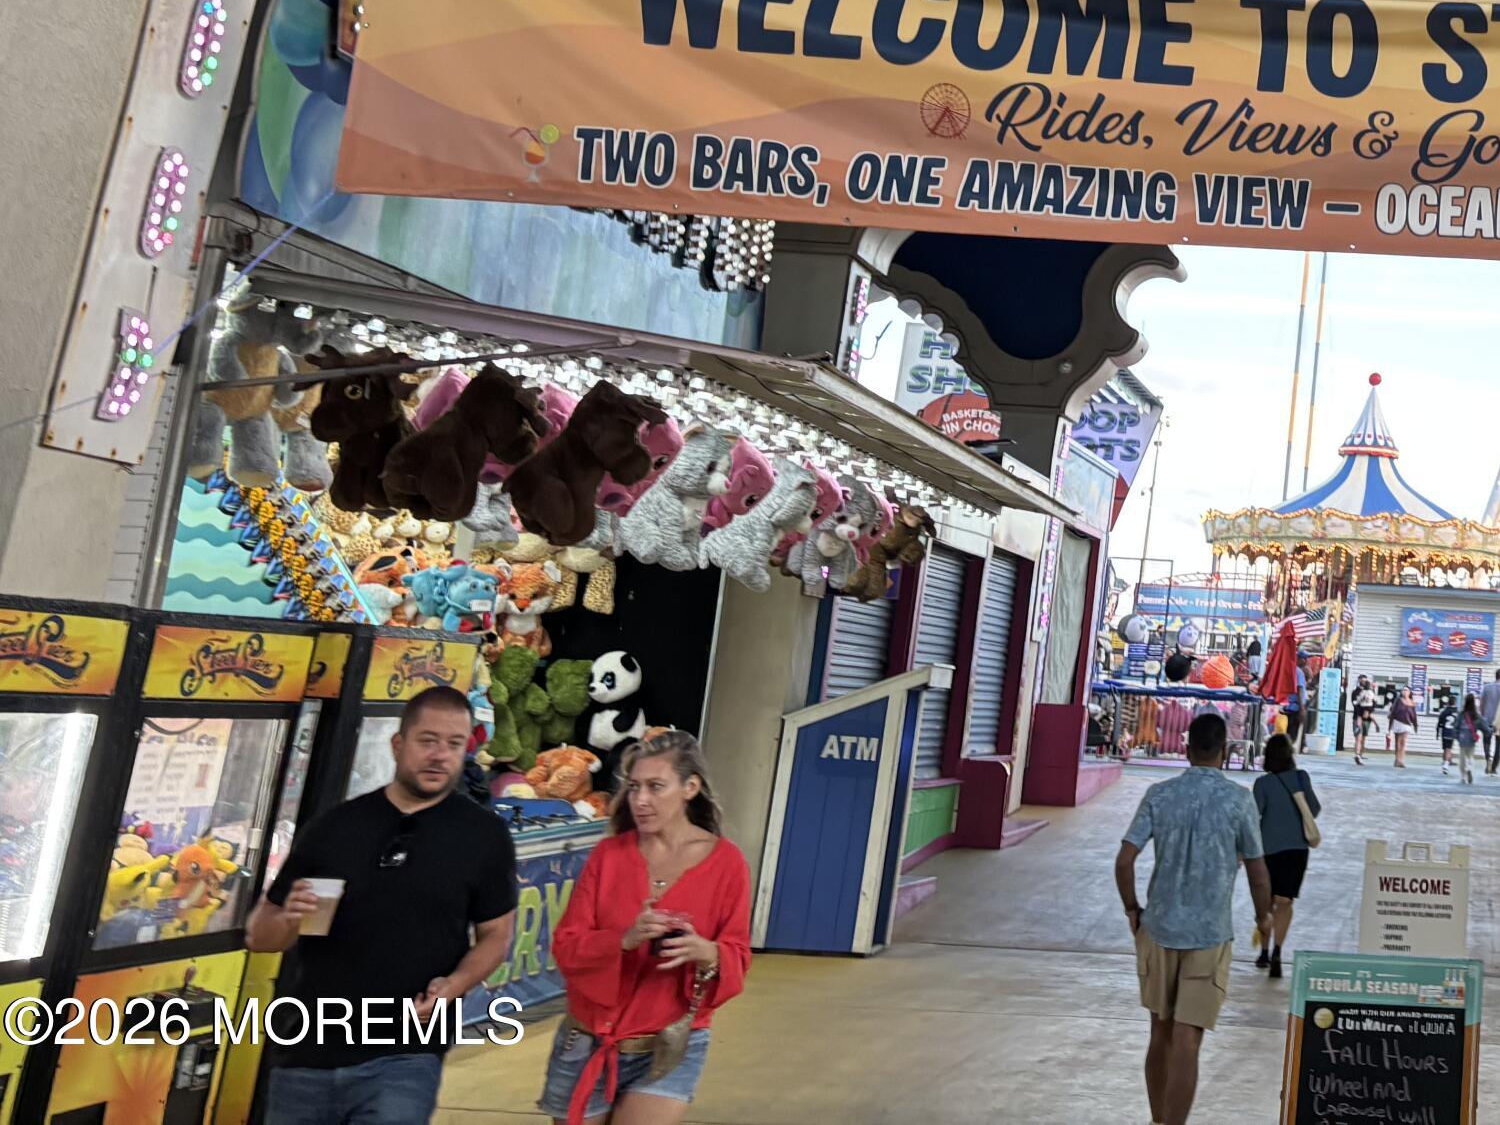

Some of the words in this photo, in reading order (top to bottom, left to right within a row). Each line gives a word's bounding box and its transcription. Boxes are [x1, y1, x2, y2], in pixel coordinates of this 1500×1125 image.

[985, 82, 1153, 153] Rides,
[1175, 98, 1338, 159] Views
[1352, 111, 1399, 159] &
[574, 126, 677, 188] TWO
[690, 134, 829, 206] BARS,
[845, 151, 948, 207] ONE
[957, 157, 1178, 223] AMAZING
[1192, 172, 1311, 229] VIEW
[819, 734, 880, 762] ATM
[1379, 876, 1451, 896] WELCOME
[1309, 977, 1363, 994] TEQUILA
[1366, 980, 1419, 996] SEASON
